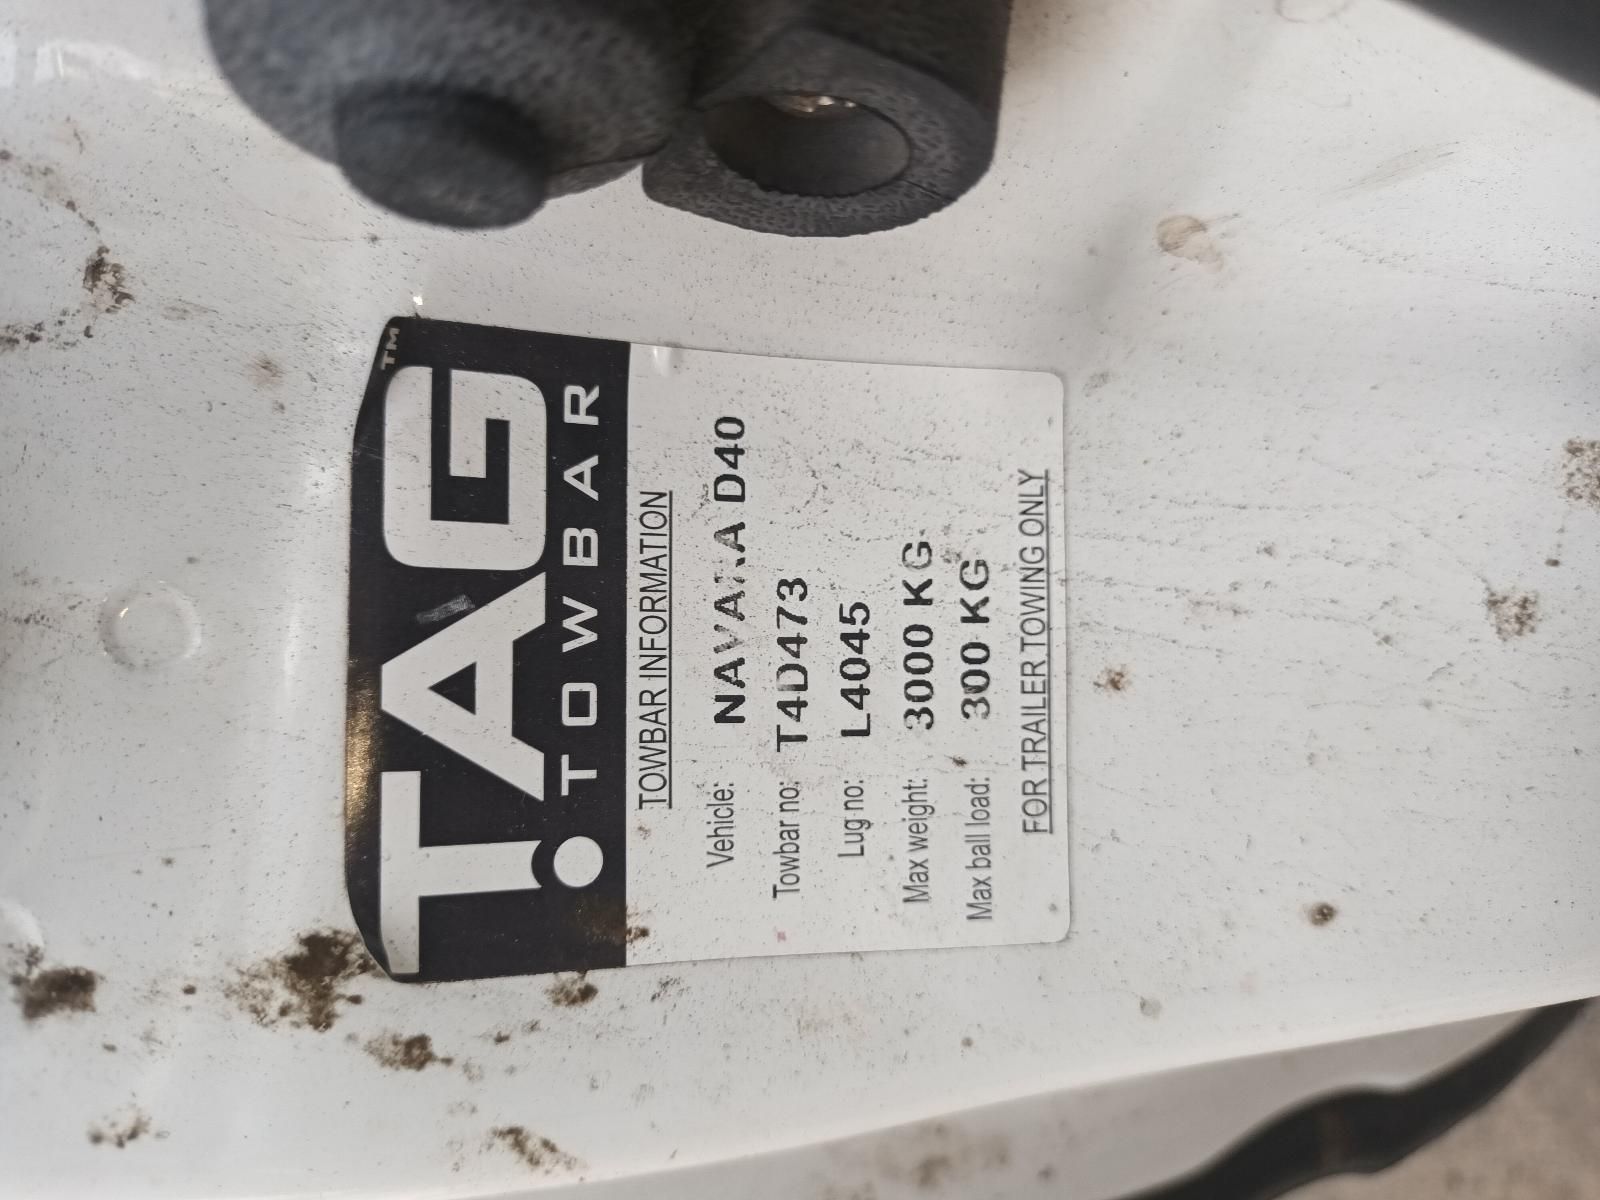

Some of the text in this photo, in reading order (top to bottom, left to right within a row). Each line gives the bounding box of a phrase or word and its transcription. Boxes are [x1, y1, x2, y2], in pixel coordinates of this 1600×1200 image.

[561, 385, 599, 796] TOWBAR
[713, 416, 746, 503] D40
[380, 366, 547, 973] TAG
[638, 491, 668, 810] TOWBAR INFORMATION
[772, 577, 809, 899] Towbar no: T4D473
[837, 601, 872, 858] Lug no: L4045
[901, 541, 936, 903] Max weight: 3000 KG
[959, 559, 993, 921] Max ball load: 300 KG
[1017, 468, 1049, 834] FOR TRAILER TOWING ONLY
[706, 782, 735, 868] Vehicle:
